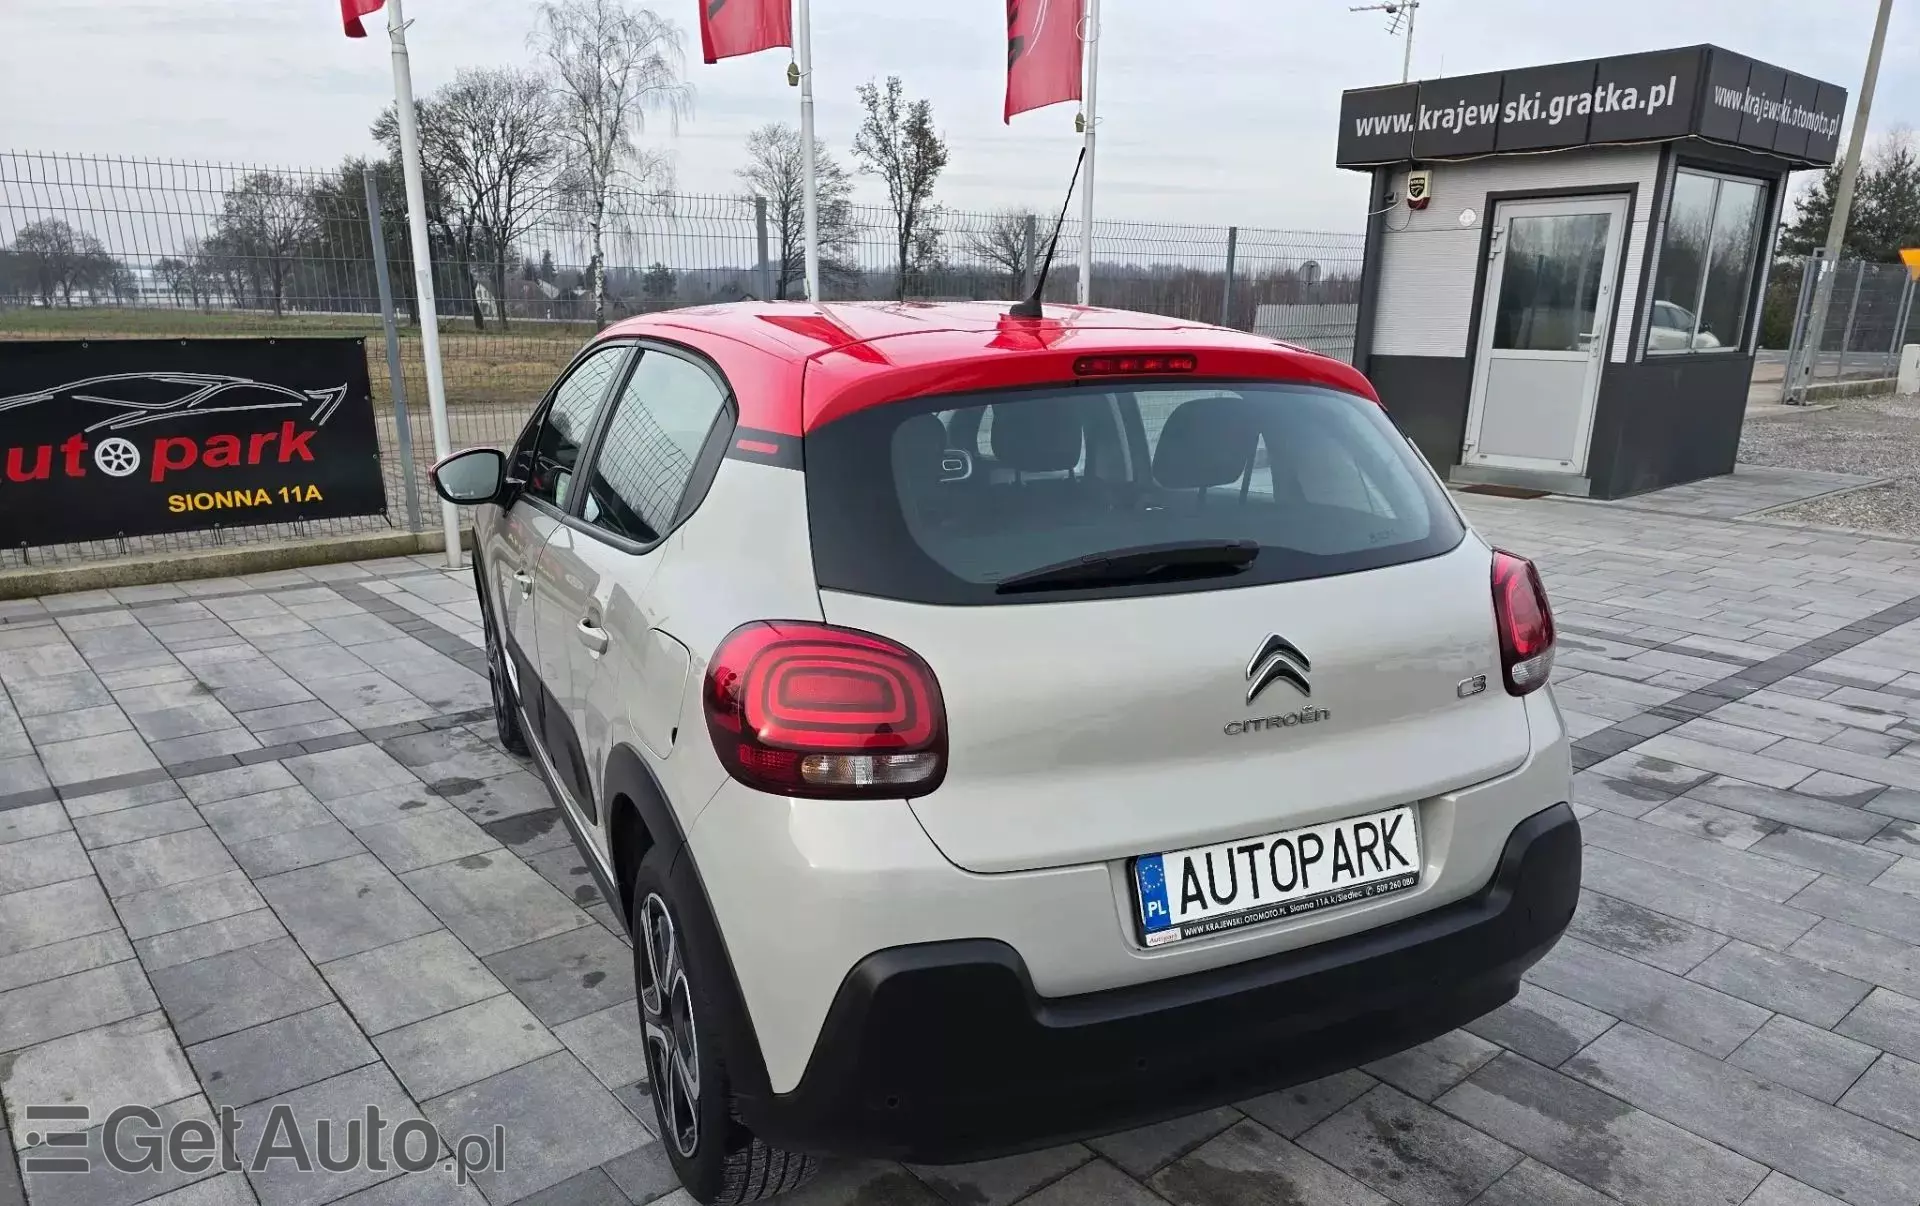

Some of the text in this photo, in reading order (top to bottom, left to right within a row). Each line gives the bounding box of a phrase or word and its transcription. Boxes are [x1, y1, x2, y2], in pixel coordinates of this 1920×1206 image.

[1355, 76, 1677, 137] www.krajewski.gratka.pl
[1714, 84, 1841, 142] www.krajewski.otomoto.pl
[168, 484, 324, 513] SIONNA 11A
[1457, 673, 1486, 698] C3
[1180, 814, 1410, 915] AUTOPARK
[1376, 883, 1388, 893] 509
[1390, 880, 1401, 889] 260
[1148, 900, 1167, 918] PL
